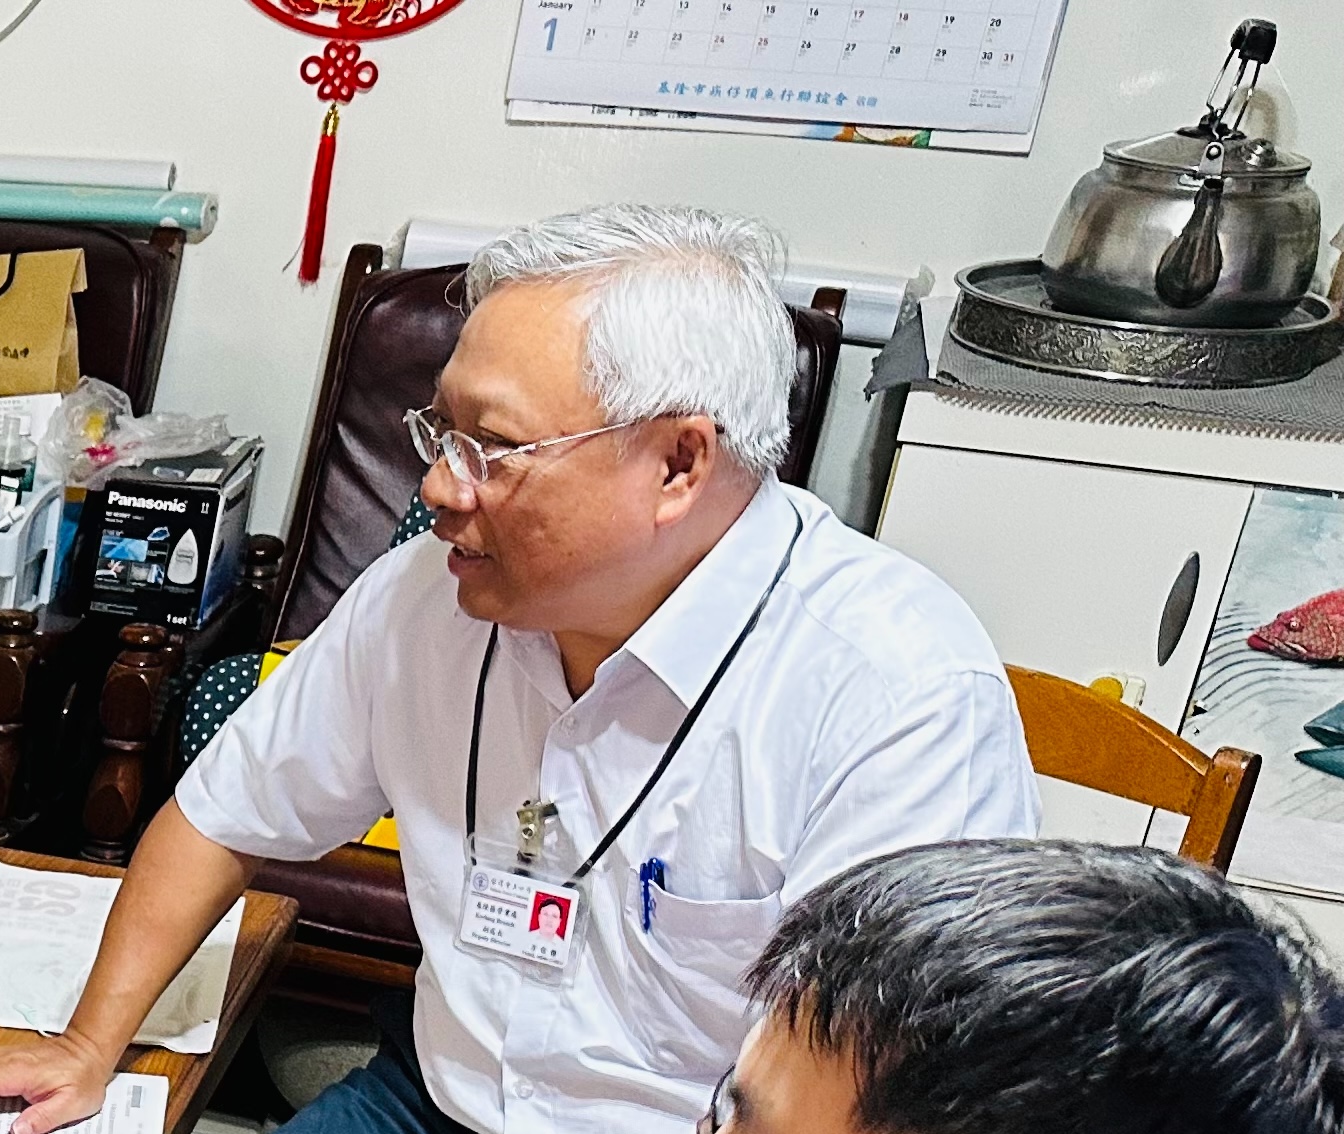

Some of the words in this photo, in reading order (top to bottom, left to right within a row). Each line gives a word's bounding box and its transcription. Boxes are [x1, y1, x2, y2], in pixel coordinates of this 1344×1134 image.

[679, 1, 689, 10] 13
[721, 2, 732, 12] 14
[765, 5, 776, 14] 15
[809, 7, 819, 17] 16
[853, 10, 864, 19] 17
[898, 12, 909, 21] 18
[944, 15, 955, 24] 19
[989, 18, 1002, 27] 20
[543, 17, 558, 51] 1
[586, 28, 595, 37] 21
[628, 30, 639, 39] 22
[672, 33, 683, 42] 23
[714, 35, 725, 44] 24
[758, 37, 769, 46] 25
[800, 40, 811, 49] 26
[845, 43, 856, 52] 27
[889, 46, 901, 55] 28
[935, 48, 946, 57] 29
[981, 51, 993, 60] 30
[1003, 53, 1014, 62] 31
[108, 491, 186, 513] Panasonic
[172, 615, 187, 625] set
